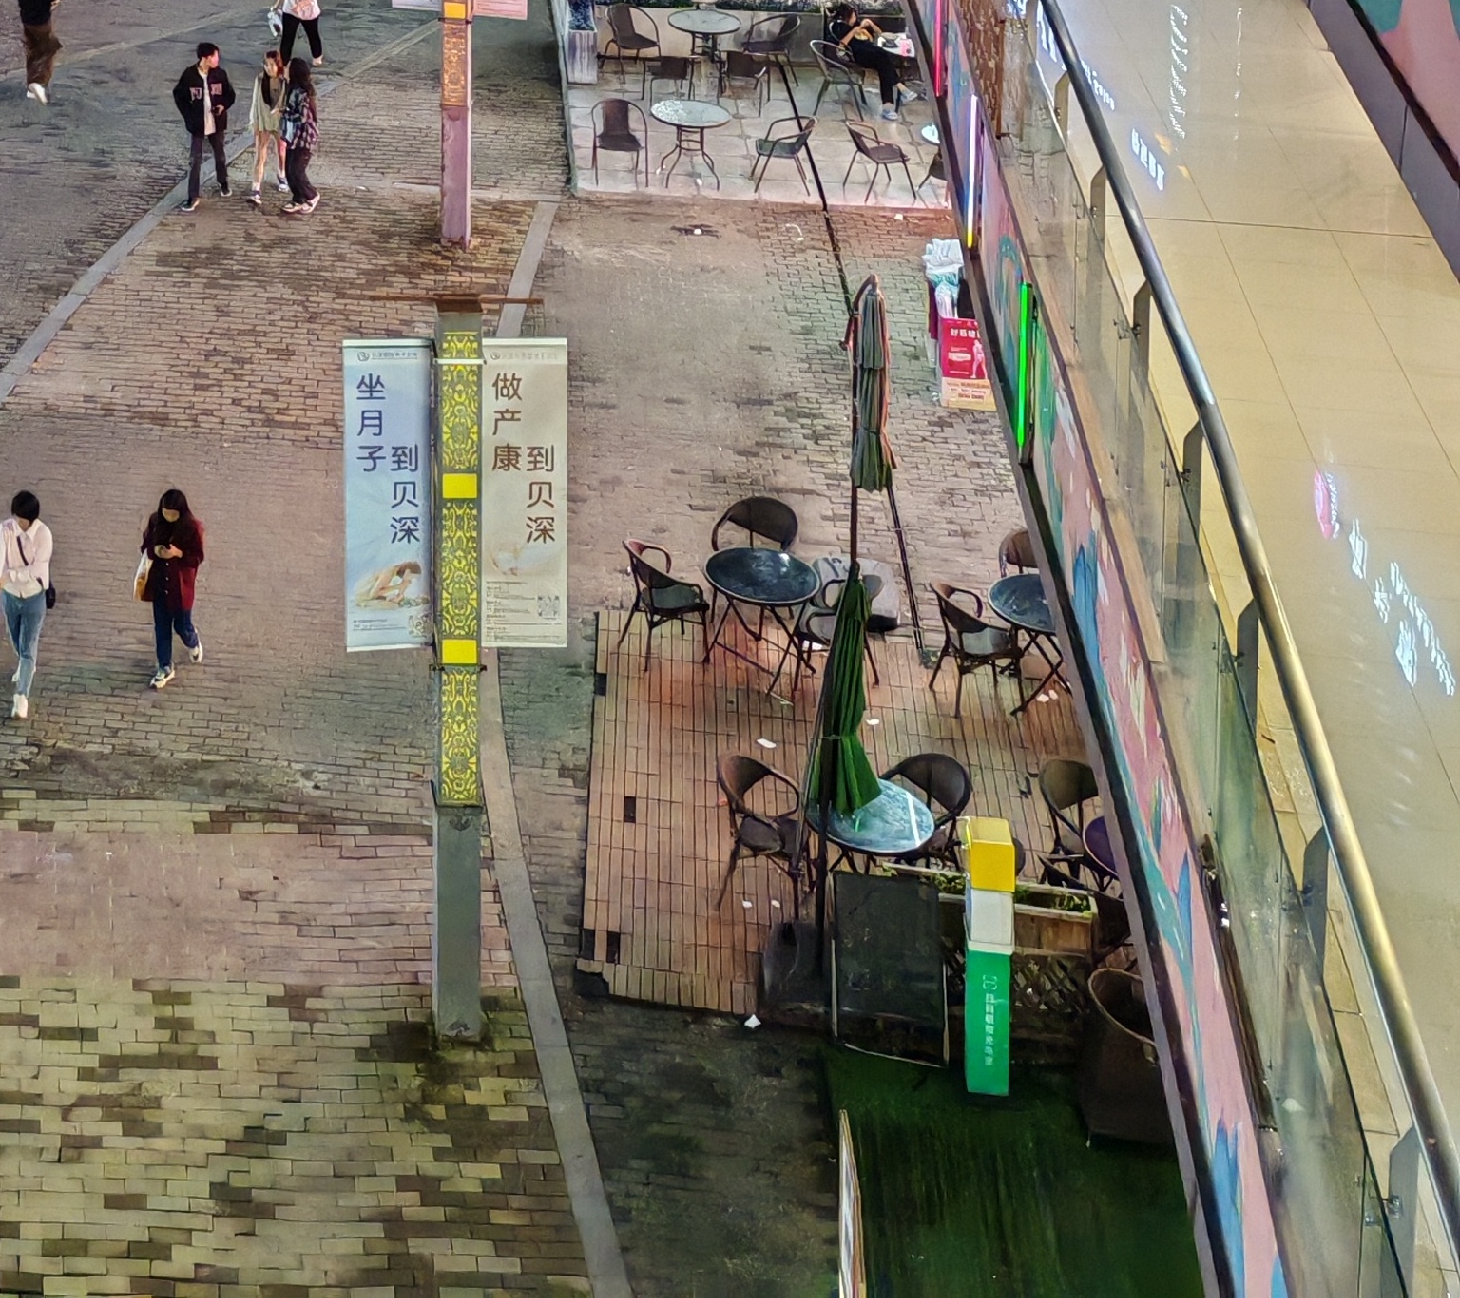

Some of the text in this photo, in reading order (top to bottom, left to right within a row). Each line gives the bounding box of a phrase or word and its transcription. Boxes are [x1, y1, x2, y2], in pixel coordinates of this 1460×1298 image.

[355, 372, 386, 473] 坐月子
[491, 372, 523, 472] 做产康
[390, 444, 420, 545] 到贝深
[526, 444, 555, 545] 到贝深
